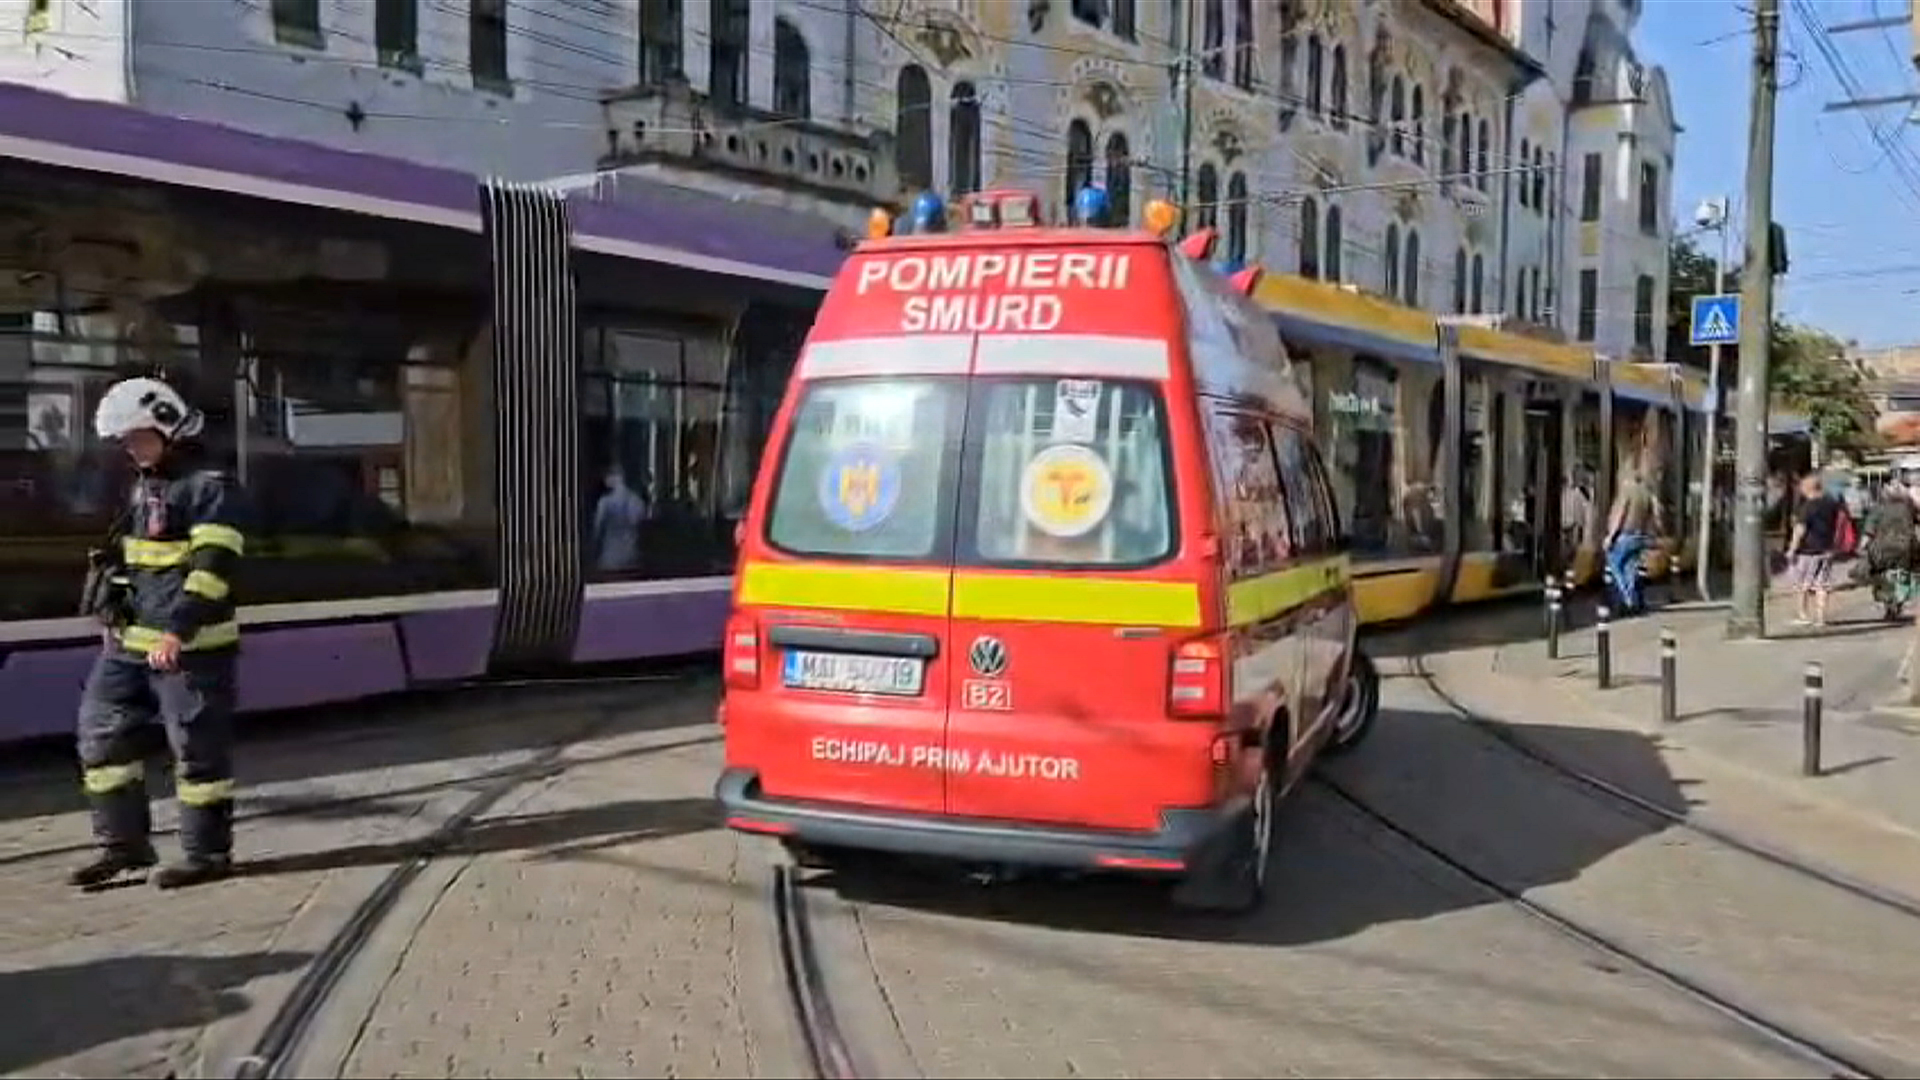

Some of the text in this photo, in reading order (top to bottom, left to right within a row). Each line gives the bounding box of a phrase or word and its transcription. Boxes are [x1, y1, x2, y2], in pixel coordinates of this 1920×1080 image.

[857, 253, 1130, 295] POMPIERII
[901, 294, 1063, 331] SMURD
[968, 684, 1004, 706] B2
[812, 738, 1080, 778] ECHIPAJ PRIM AJUTOR
